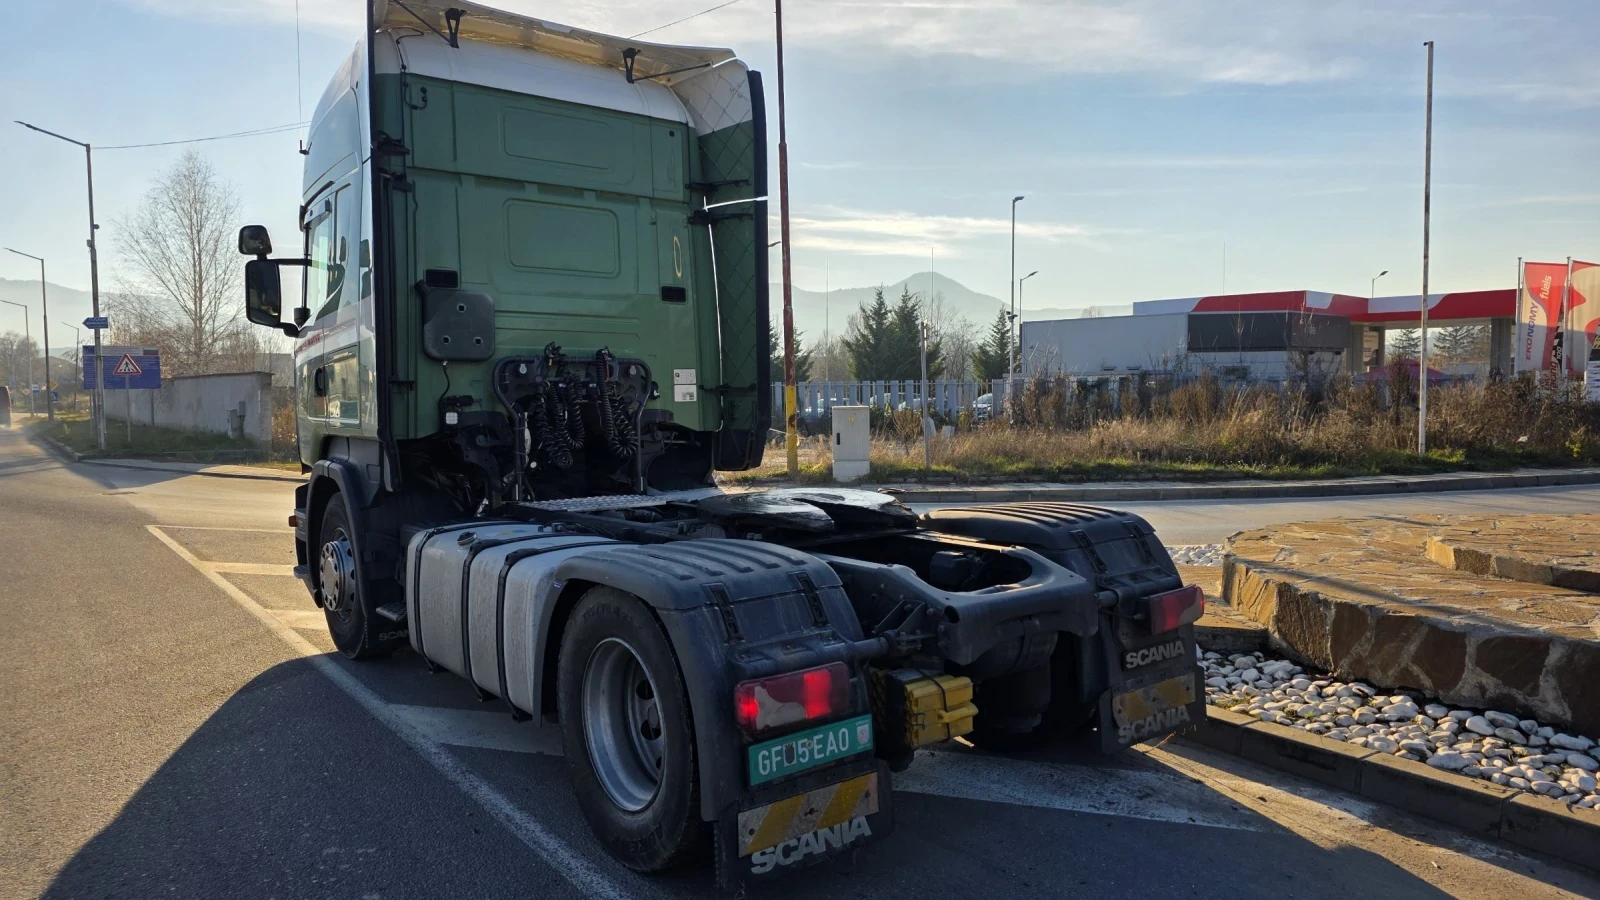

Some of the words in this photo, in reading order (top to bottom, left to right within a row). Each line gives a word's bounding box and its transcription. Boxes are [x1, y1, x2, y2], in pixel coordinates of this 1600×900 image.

[1540, 275, 1552, 299] fuels
[1526, 302, 1539, 361] EKONOMY
[1125, 640, 1185, 669] SCANIA
[1118, 705, 1191, 744] SCANIA
[751, 815, 872, 874] SCANIA
